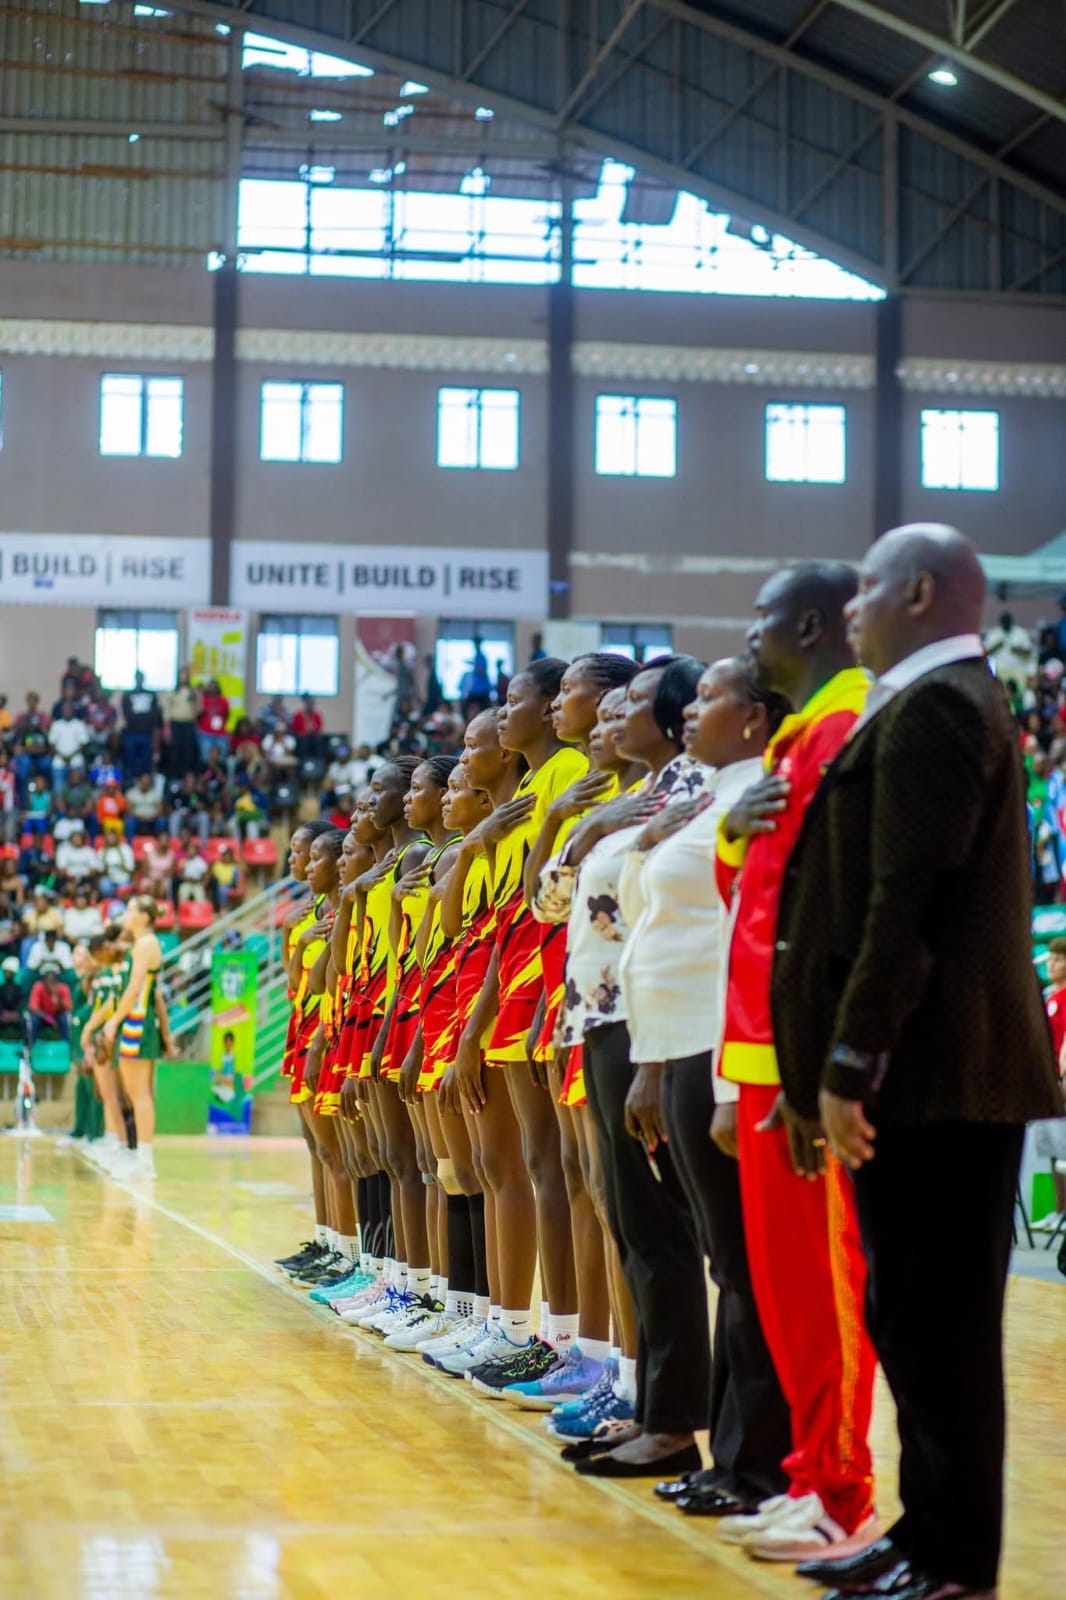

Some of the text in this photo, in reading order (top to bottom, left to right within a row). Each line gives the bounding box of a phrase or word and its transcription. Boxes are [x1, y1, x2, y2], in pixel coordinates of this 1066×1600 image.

[12, 553, 186, 580] BUILD RISE
[246, 562, 329, 588] UNITE
[352, 563, 436, 589] BUILD
[459, 565, 522, 591] RISE
